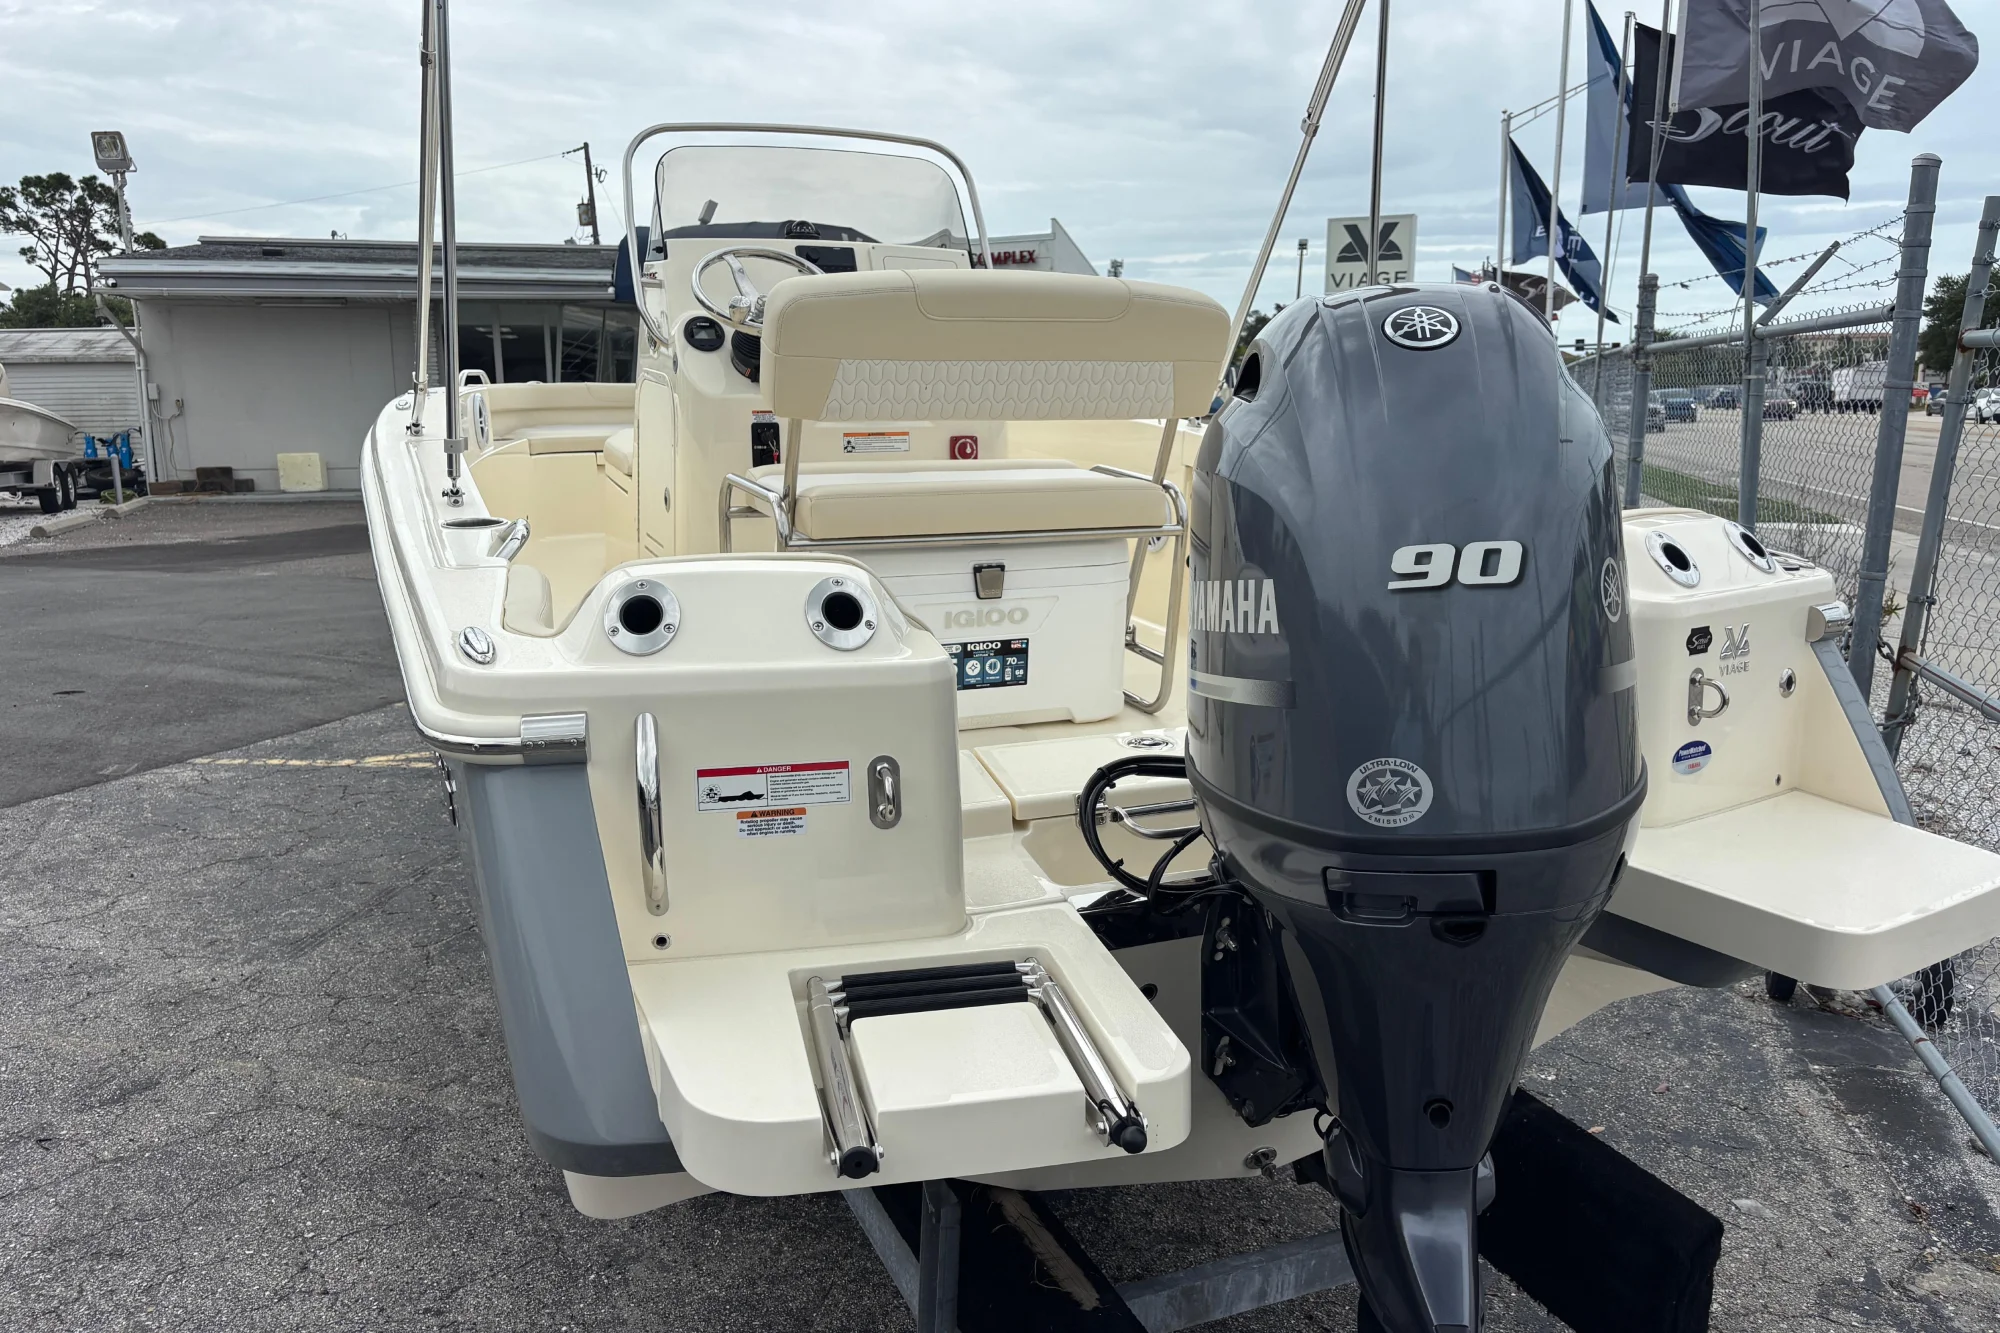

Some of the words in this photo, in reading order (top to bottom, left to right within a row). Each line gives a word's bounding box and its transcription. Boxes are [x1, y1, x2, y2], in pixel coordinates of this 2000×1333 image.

[1760, 39, 1906, 111] VIAGE
[1387, 540, 1523, 590] 90
[1193, 578, 1280, 634] YAMAHA
[944, 607, 1029, 629] IGLOO
[967, 642, 1001, 651] IGLOO
[1006, 657, 1017, 665] 70
[1719, 660, 1750, 677] VIAGE
[758, 808, 795, 817] WARNING
[1368, 813, 1415, 825] EMISSION
